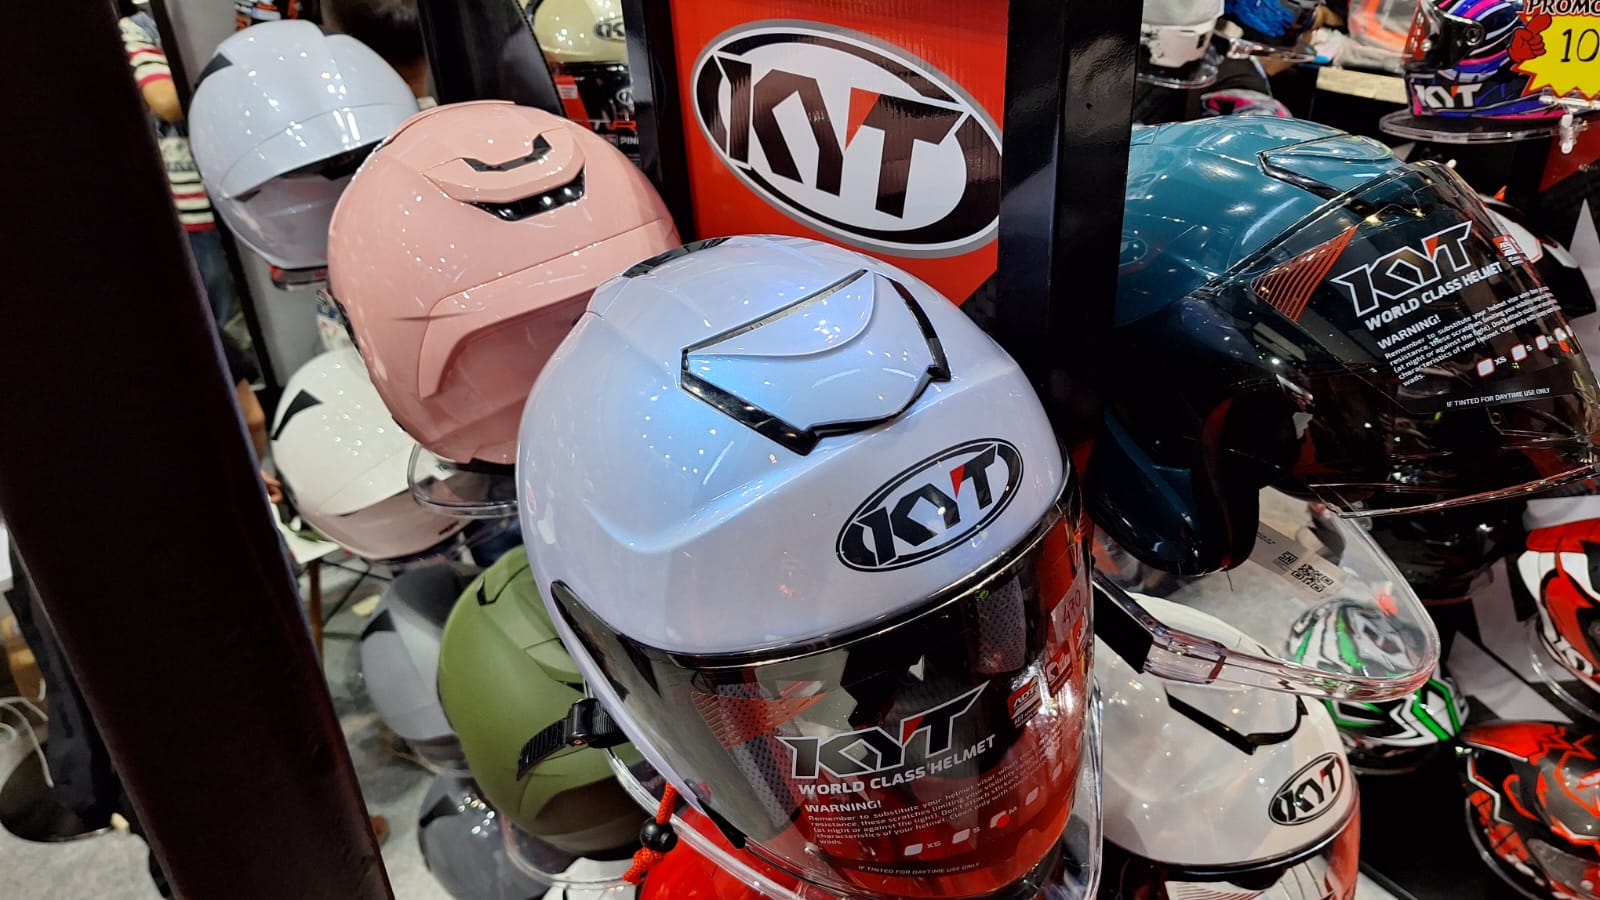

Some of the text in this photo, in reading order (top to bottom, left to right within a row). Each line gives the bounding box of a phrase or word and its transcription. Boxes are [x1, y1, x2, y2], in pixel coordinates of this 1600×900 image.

[1413, 83, 1483, 109] KYT
[716, 56, 964, 219] KYT
[1330, 220, 1473, 318] KYT
[1364, 261, 1504, 331] WORLD CLASS HELMET
[1377, 314, 1441, 349] WARNING!
[1384, 338, 1425, 359] Remember
[1437, 316, 1472, 335] substitute
[1472, 310, 1487, 320] your
[1429, 335, 1451, 347] these
[1393, 364, 1406, 373] (at
[1405, 354, 1426, 367] night
[1426, 350, 1435, 358] or
[1435, 338, 1461, 355] against
[1461, 333, 1474, 342] the
[1398, 350, 1453, 380] characteristics
[1452, 346, 1461, 354] of
[1461, 340, 1477, 352] your
[1494, 355, 1507, 366] XS
[1525, 344, 1533, 352] S
[1454, 397, 1480, 406] TINTED
[1480, 395, 1494, 403] FOR
[1495, 391, 1524, 401] DAYTIME
[1523, 389, 1535, 397] USE
[1536, 387, 1550, 395] ONLY
[856, 443, 997, 567] KYT
[774, 680, 990, 779] KYT
[799, 780, 865, 795] WORLD
[870, 766, 926, 789] CLASS
[930, 734, 996, 775] HELMET
[804, 800, 882, 813] WARNING!
[873, 805, 920, 819] substitute
[922, 797, 942, 809] your
[945, 785, 975, 799] helmet
[1280, 758, 1337, 821] KYT
[888, 807, 931, 822] scratches
[932, 797, 965, 812] limiting
[926, 840, 942, 849] XS
[1008, 806, 1017, 815] M
[863, 824, 896, 834] against
[894, 826, 913, 835] your
[867, 865, 894, 874] TINTED
[912, 867, 945, 875] DAYTIME
